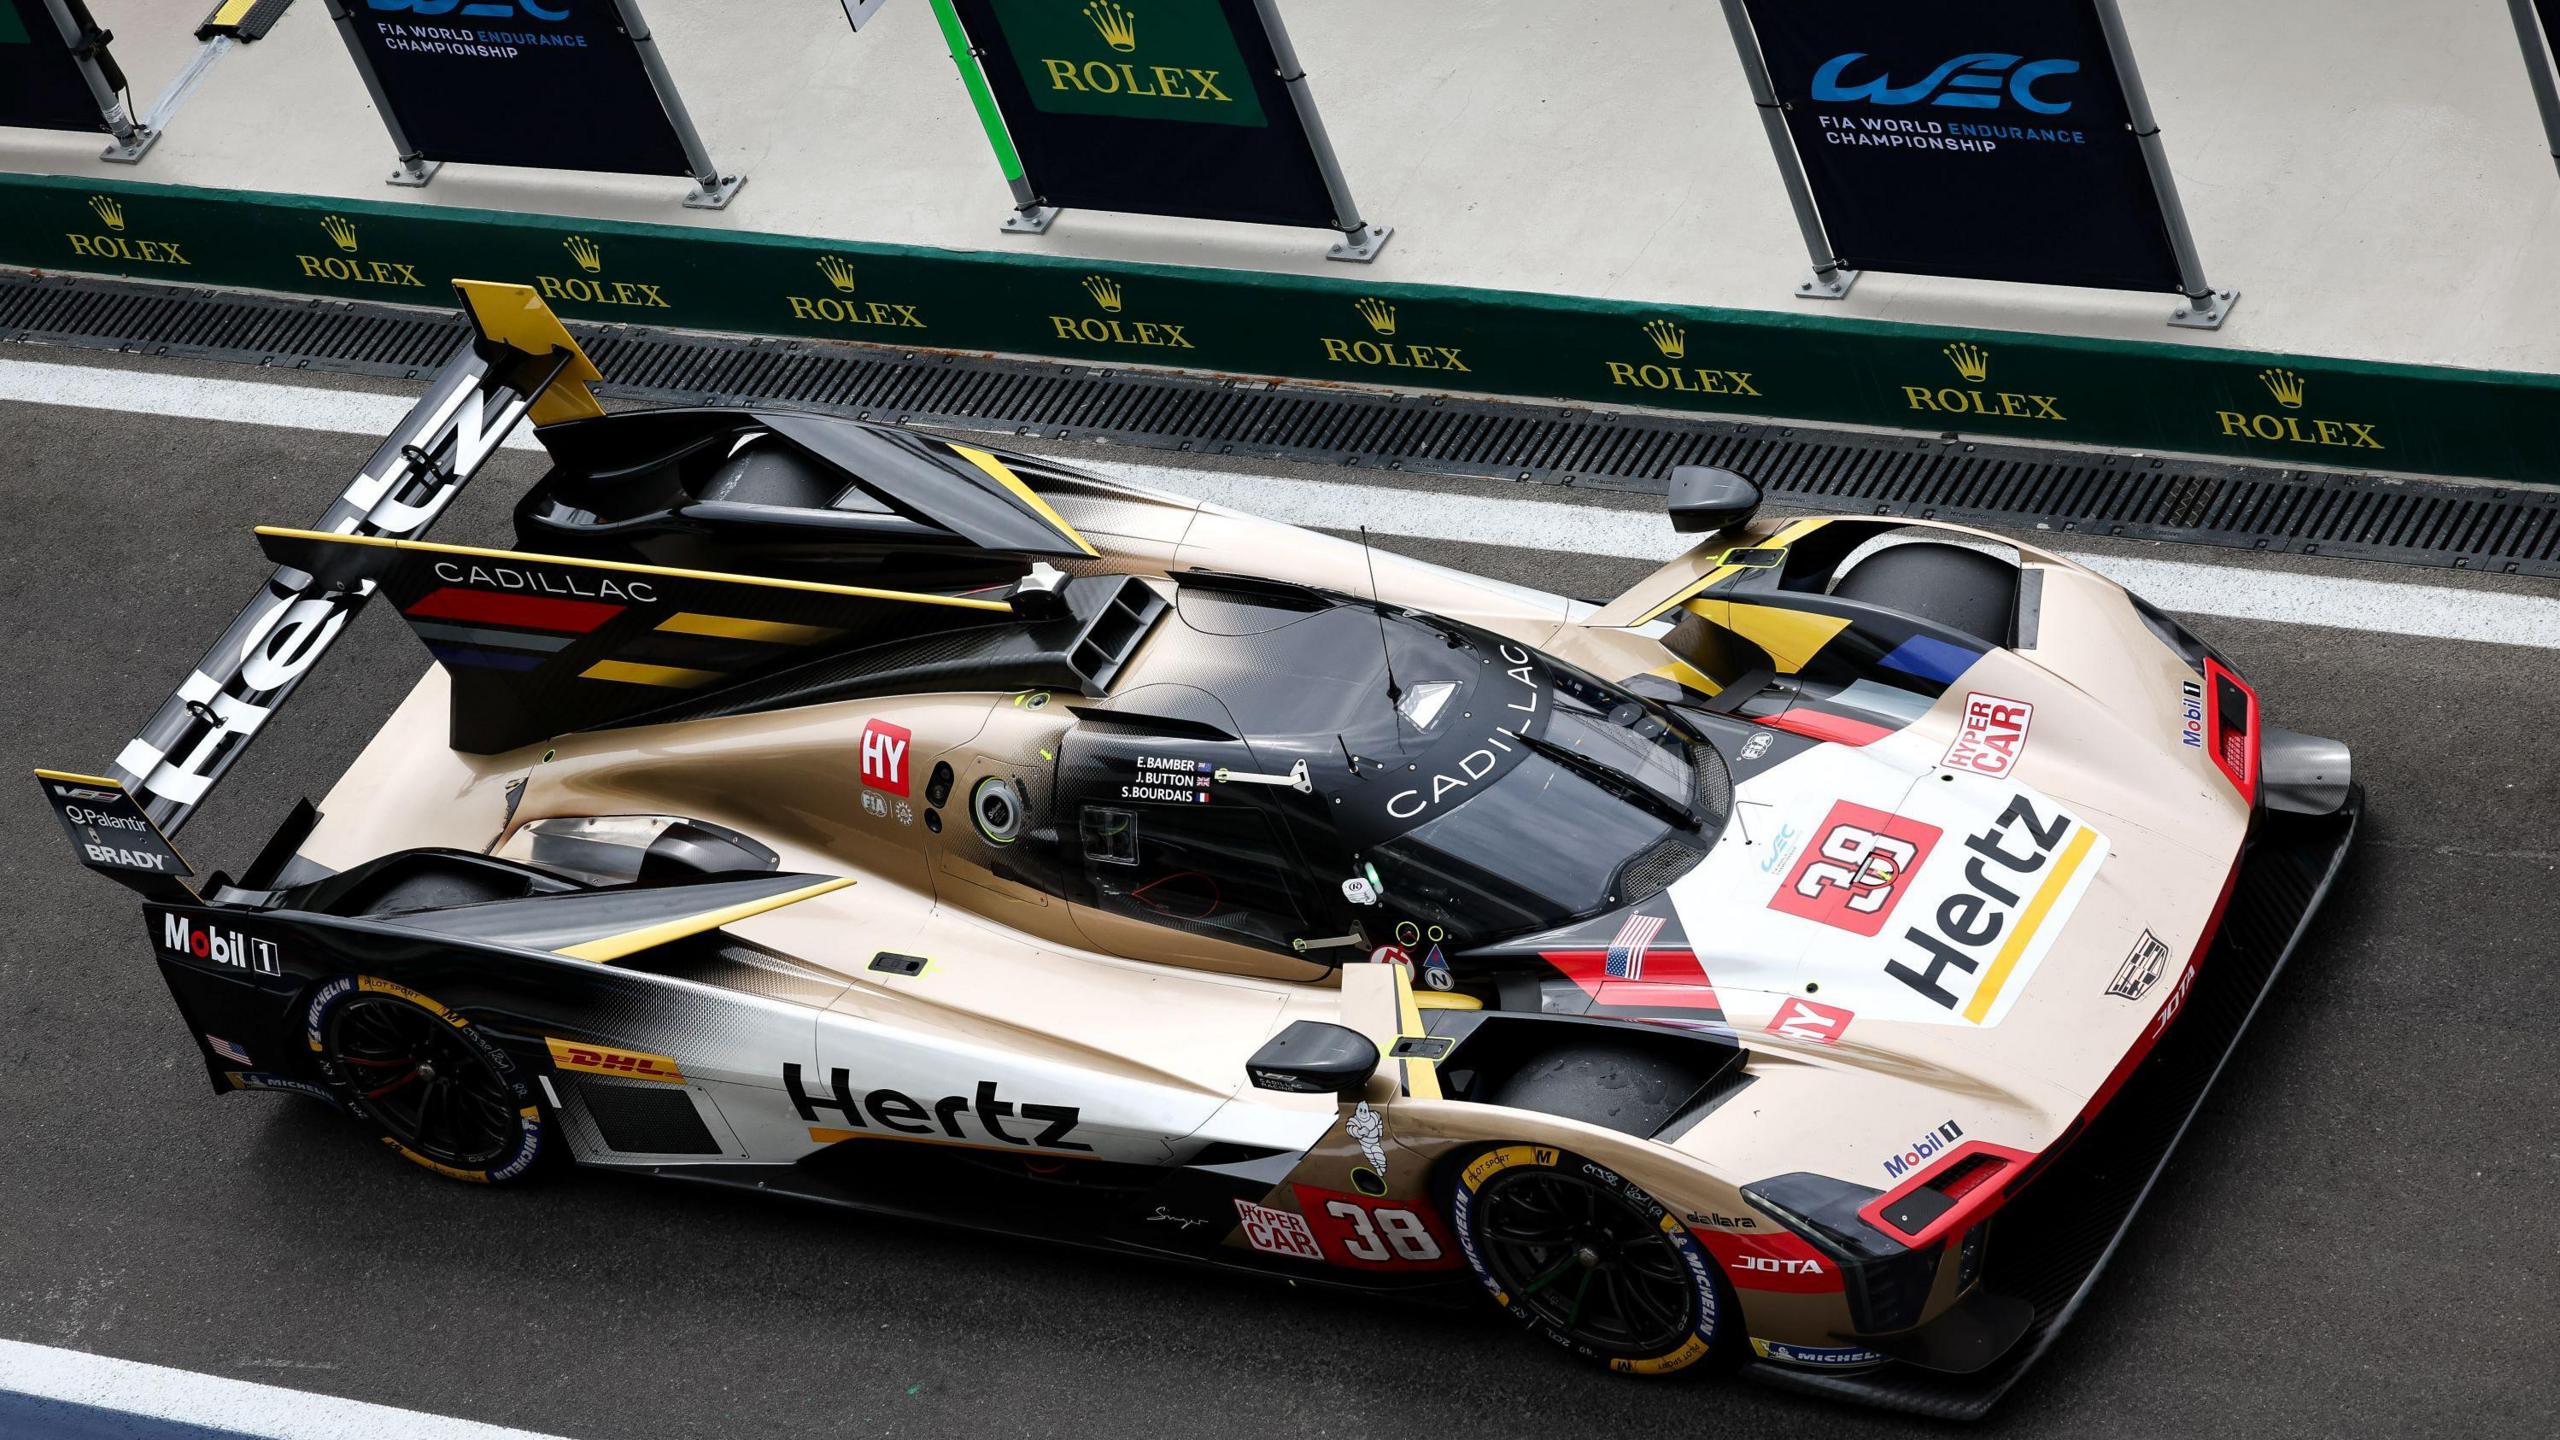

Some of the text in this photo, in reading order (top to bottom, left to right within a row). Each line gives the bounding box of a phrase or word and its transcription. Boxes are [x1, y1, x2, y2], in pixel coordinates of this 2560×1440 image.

[377, 22, 588, 48] FIA WORLD ENDURANCE
[385, 38, 519, 59] CHAMPIONSHIP
[1041, 58, 1233, 103] ROLEX
[1811, 53, 2080, 115] WEC
[1818, 115, 2086, 145] FIA WORLD ENDURANCE
[1825, 131, 1997, 152] CHAMPIONSHIP
[66, 233, 192, 265] ROLEX
[296, 254, 426, 287] ROLEX
[536, 275, 671, 308] ROLEX
[786, 296, 928, 329] ROLEX
[1049, 316, 1195, 349] ROLEX
[1323, 338, 1473, 372] ROLEX
[1605, 361, 1762, 397] ROLEX
[1901, 385, 2068, 421] ROLEX
[2215, 410, 2385, 449] ROLEX
[115, 375, 528, 806] Hetz
[434, 562, 658, 603] CADILLAC
[1386, 644, 1539, 819] CADILLAC
[1948, 701, 1992, 767] HYPER
[1971, 704, 2026, 773] CAR
[2182, 698, 2202, 748] Mobil
[862, 729, 906, 784] HY
[1136, 756, 1195, 772] E.BAMBER
[1121, 786, 1193, 802] S.BOURDAIS
[83, 808, 147, 832] Palantir
[84, 843, 165, 871] BRADY
[1884, 793, 2073, 1010] Hertz
[165, 912, 247, 969] Mobil
[308, 978, 351, 1028] MICHELIN
[2151, 964, 2196, 1040] JOTA
[568, 1047, 665, 1075] DHL
[782, 1062, 1094, 1152] Hertz
[494, 1133, 538, 1180] MICHELIN
[1485, 1154, 1511, 1169] SPORT
[1536, 1149, 1553, 1164] M
[1883, 1131, 1945, 1179] Mobil
[1239, 1202, 1303, 1233] HYPER
[1326, 1200, 1442, 1262] 38
[1455, 1188, 1486, 1274] MICHELIN
[1687, 1211, 1757, 1228] dallara
[1247, 1222, 1318, 1257] CAR
[1731, 1255, 1824, 1274] JOTA
[1683, 1251, 1715, 1337] MICHELIN
